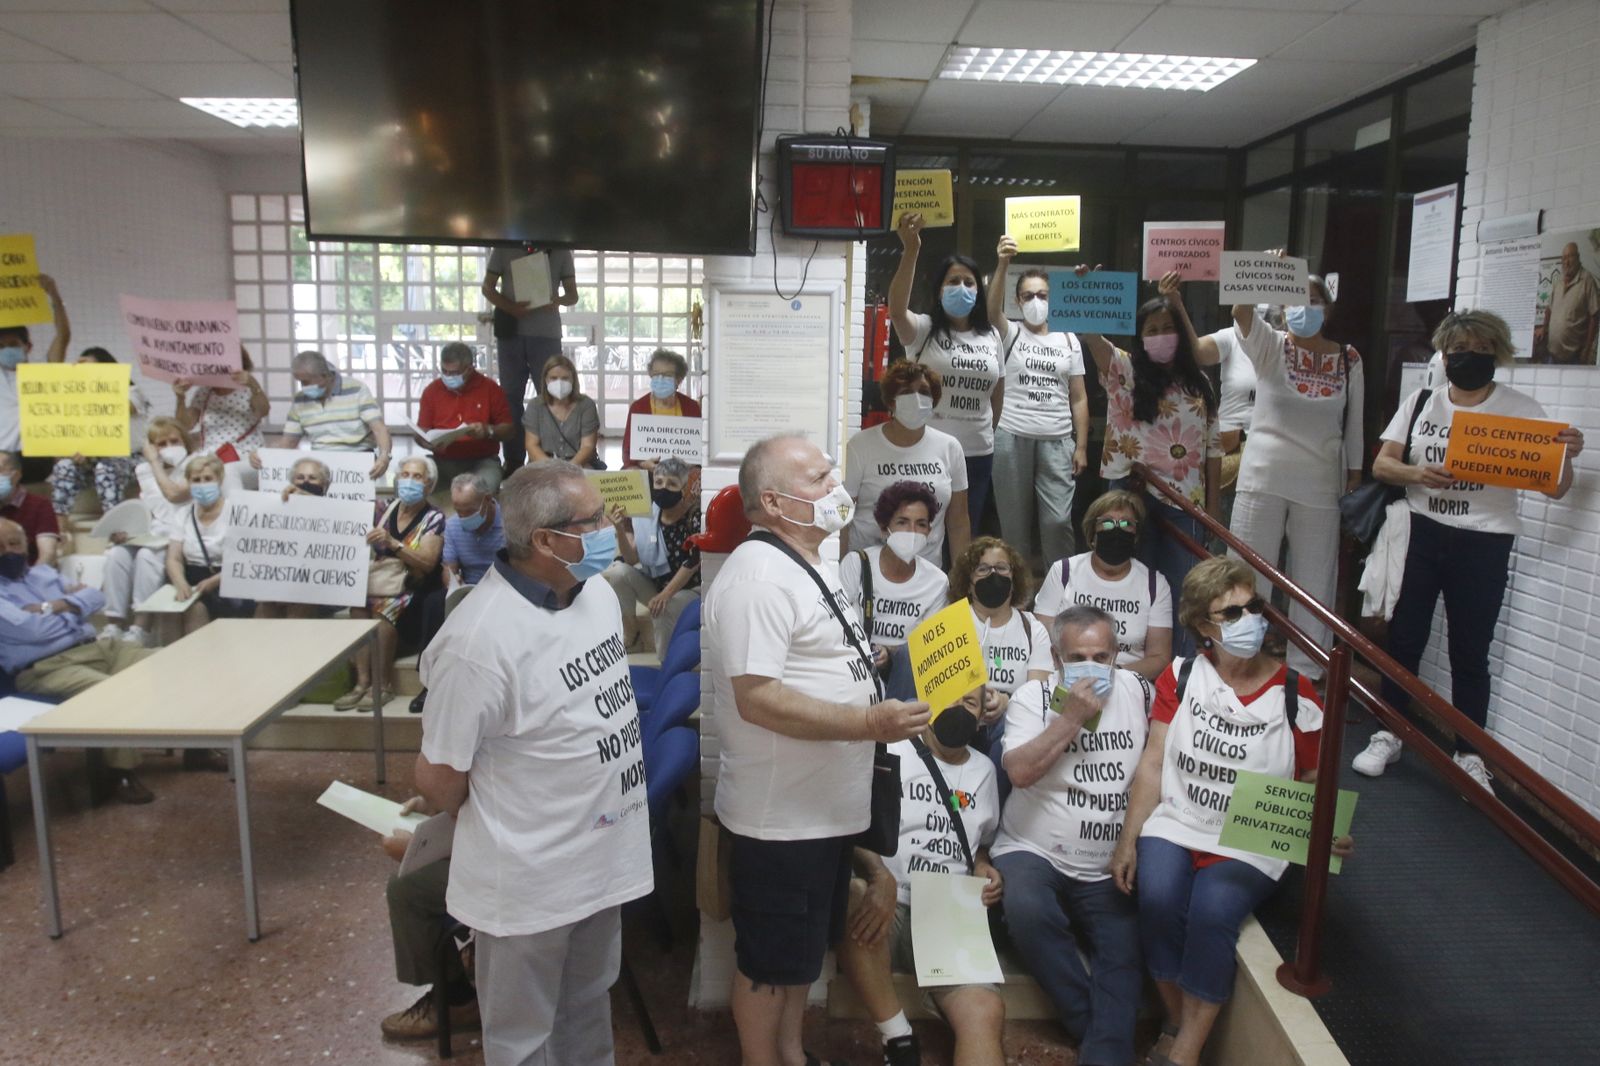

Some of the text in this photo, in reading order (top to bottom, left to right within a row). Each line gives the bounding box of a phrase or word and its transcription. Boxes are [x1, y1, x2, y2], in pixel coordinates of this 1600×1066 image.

[808, 149, 869, 160] SU TURNO
[895, 178, 933, 187] TENCIÓN
[1011, 209, 1075, 219] MÁS CONTRATOS
[1030, 221, 1057, 229] MENOS
[1025, 232, 1063, 241] RECORTES
[1150, 237, 1220, 246] CENTROS CÍVICOS
[1158, 250, 1211, 258] REFORZADOS
[1234, 260, 1296, 270] LOS CENTROS
[1235, 270, 1295, 281] CÍVICOS SON
[1062, 281, 1124, 290] LOS CENTROS
[1223, 284, 1306, 294] CASAS VECINALES
[1063, 294, 1122, 305] CÍVICOS SON
[1051, 309, 1132, 320] CASAS VECINALES
[951, 355, 989, 372] CÍVICOS
[1025, 357, 1057, 372] CÍVICOS
[942, 375, 956, 388] NO
[1018, 374, 1030, 384] NO
[950, 395, 981, 410] MORIR
[1028, 391, 1052, 402] MORIR
[637, 425, 700, 436] UNA DIRECTORA
[1463, 425, 1488, 438] LOS
[1491, 428, 1552, 445] CENTROS
[646, 437, 691, 446] PARA CADA
[639, 446, 698, 456] CENTRO CÍVICO
[1466, 443, 1541, 463] CÍVICOS NO
[329, 468, 365, 485] LÍTICOS
[877, 462, 942, 476] LOS CENTROS
[1451, 459, 1552, 481] PUEDEN MORIR
[1428, 496, 1469, 516] MORIR
[229, 504, 248, 528] NO
[248, 513, 258, 528] A
[332, 519, 368, 537] NUEVAS
[236, 537, 356, 561] QUEREMOS ABIERTO
[232, 562, 246, 579] EL
[876, 598, 921, 618] CENTROS
[1073, 591, 1140, 615] LOS CENTROS
[922, 622, 946, 646] NO ES
[917, 633, 969, 677] MOMENTO DE
[559, 657, 590, 692] LOS
[923, 655, 971, 698] RETROCESOS
[1190, 696, 1268, 738] LOS CENTROS
[596, 713, 640, 764] NO PUE
[1081, 729, 1134, 753] CENTROS
[1193, 728, 1247, 760] CÍVICOS
[1073, 759, 1125, 783] CÍVICOS
[1177, 751, 1238, 784] NO PUED
[621, 759, 646, 796] MOR
[909, 782, 932, 803] LOS
[1067, 787, 1086, 808] NO
[1270, 839, 1290, 852] NO
